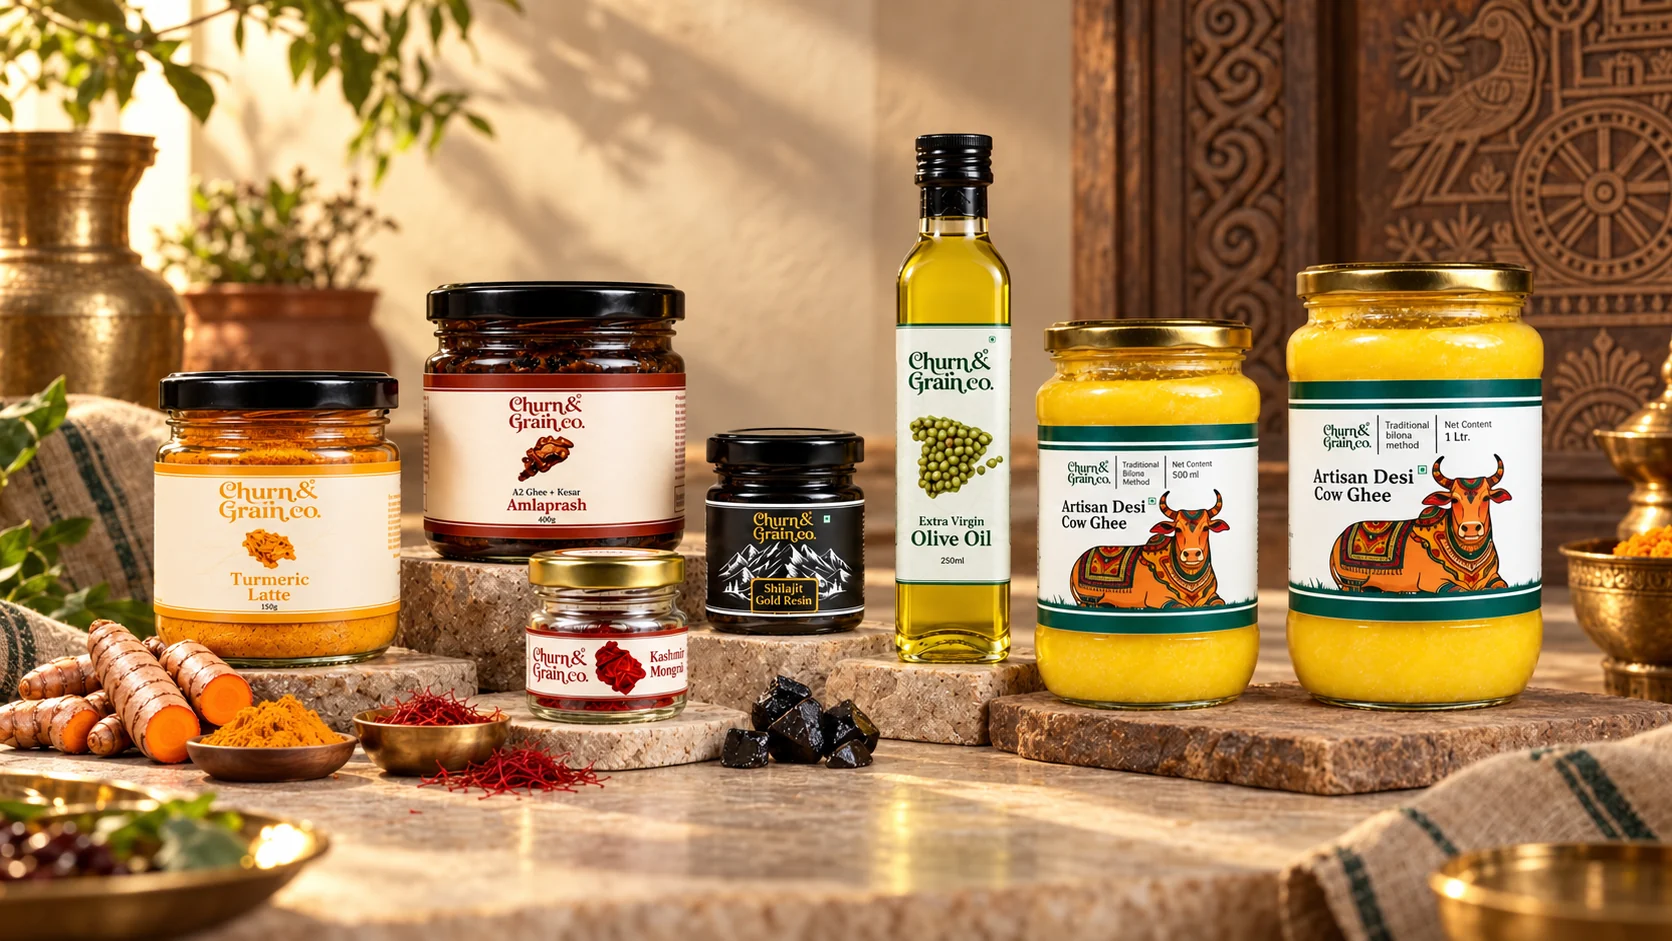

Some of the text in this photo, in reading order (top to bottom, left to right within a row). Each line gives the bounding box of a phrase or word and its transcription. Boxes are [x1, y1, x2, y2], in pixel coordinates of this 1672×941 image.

[1385, 420, 1430, 429] Traditional
[1444, 420, 1492, 429] Net Content
[1385, 431, 1412, 440] bilona
[1445, 432, 1471, 442] 1 Ltr.
[1385, 441, 1420, 449] method
[1186, 460, 1213, 468] Content
[1172, 470, 1200, 479] 500 ml
[1313, 468, 1414, 485] Artisan Desi
[1122, 478, 1150, 486] Method
[512, 488, 524, 496] A2
[526, 488, 548, 496] Ghee
[557, 488, 581, 496] Kesar
[1314, 486, 1392, 502] Cow Ghee
[506, 498, 587, 515] Amlaprash
[1061, 499, 1146, 514] Artisan Desi
[538, 516, 556, 524] 400g
[919, 516, 985, 529] Extra Virgin
[1061, 515, 1127, 530] Cow Ghee
[911, 530, 992, 547] Olive Oil
[940, 557, 965, 565] 250ml
[230, 572, 309, 586] Turmeric
[764, 583, 803, 595] Shilajit
[248, 588, 290, 601] Latte
[756, 595, 812, 606] Gold Resin
[261, 603, 278, 611] 150g
[650, 647, 685, 663] Kashmir
